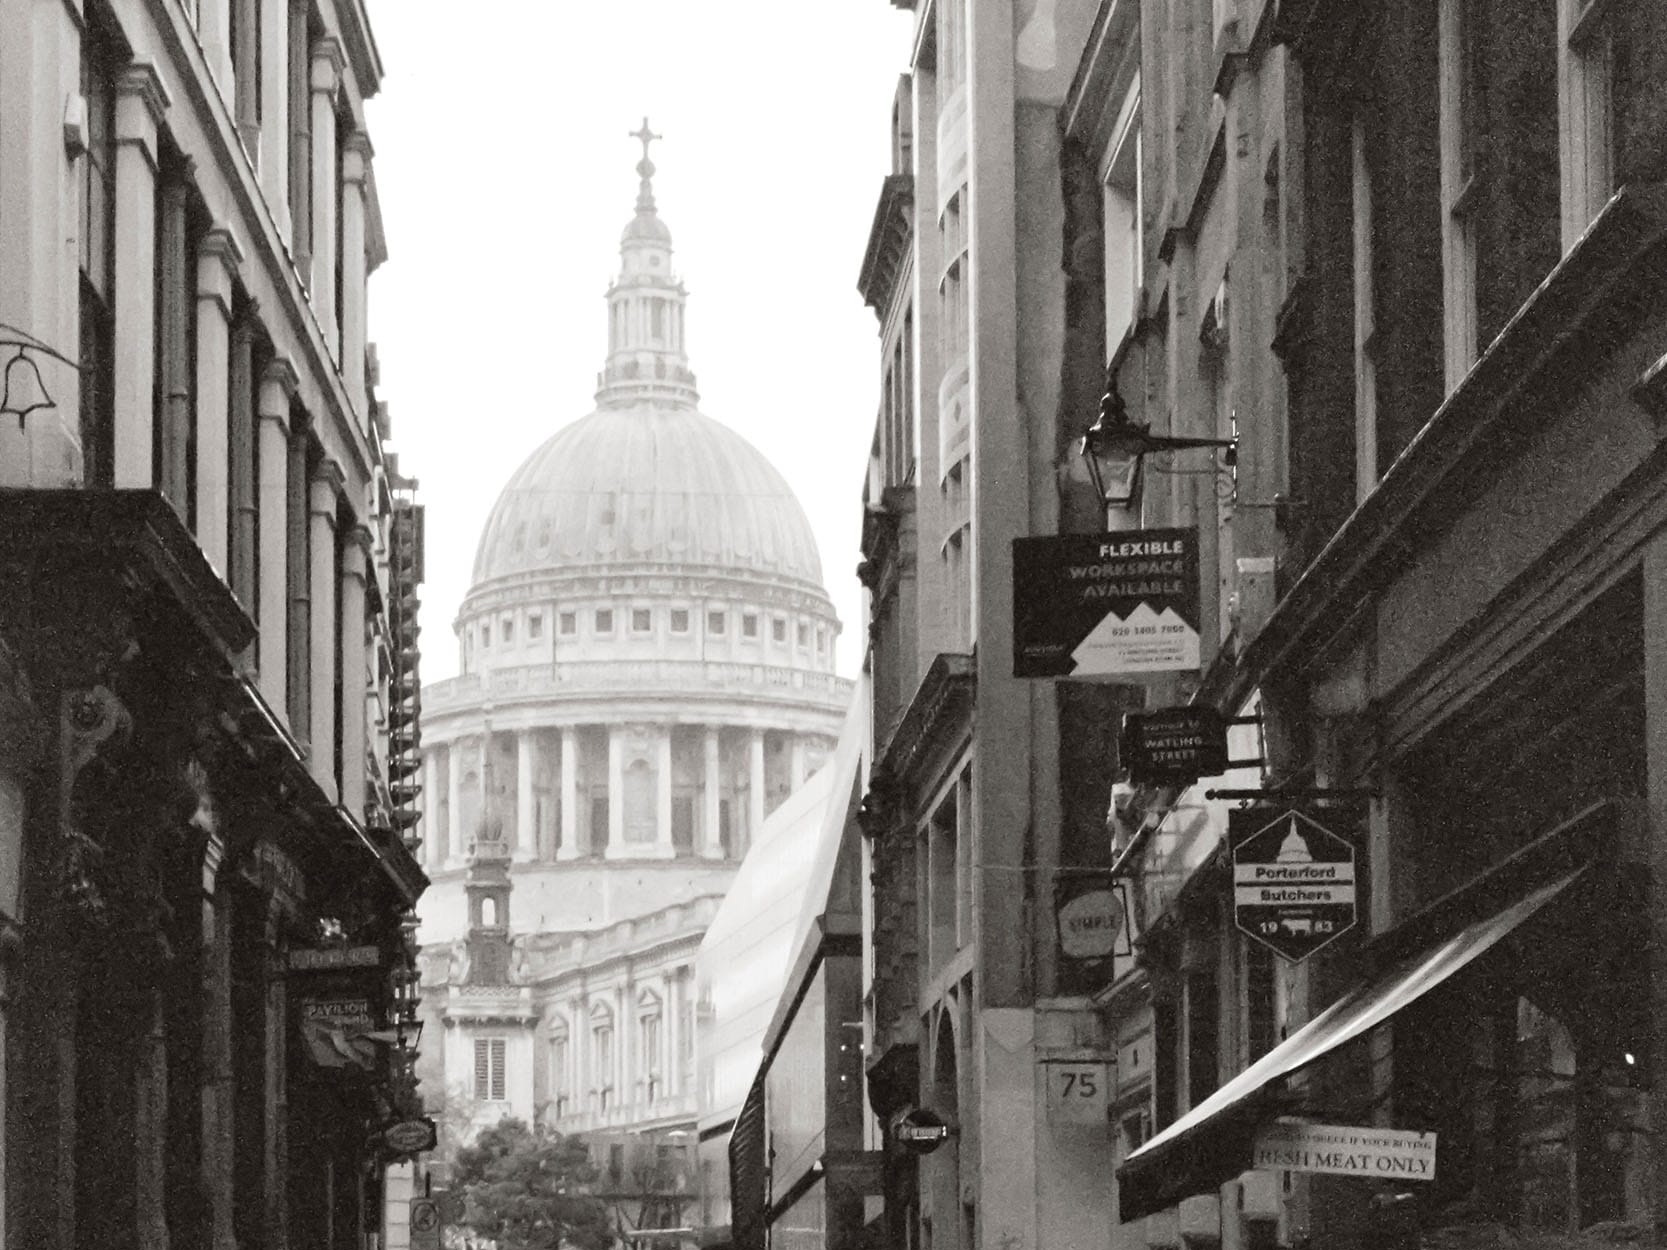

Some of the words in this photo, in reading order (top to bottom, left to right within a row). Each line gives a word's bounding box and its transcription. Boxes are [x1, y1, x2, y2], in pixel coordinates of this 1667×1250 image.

[1100, 540, 1183, 556] FLEXIBLE
[1069, 559, 1183, 578] WORKSPACE
[1083, 580, 1182, 599] AVAILABLE
[1145, 736, 1202, 748] WATLING
[1152, 749, 1195, 761] STREET
[1256, 866, 1335, 879] Porterford
[1261, 889, 1331, 901] Butchers
[1260, 921, 1278, 933] 19
[306, 1002, 368, 1016] PAVILION
[1061, 1072, 1097, 1098] 75
[1259, 1149, 1309, 1167] RESH
[1315, 1153, 1372, 1170] MEAT
[1376, 1156, 1431, 1174] ONLY
